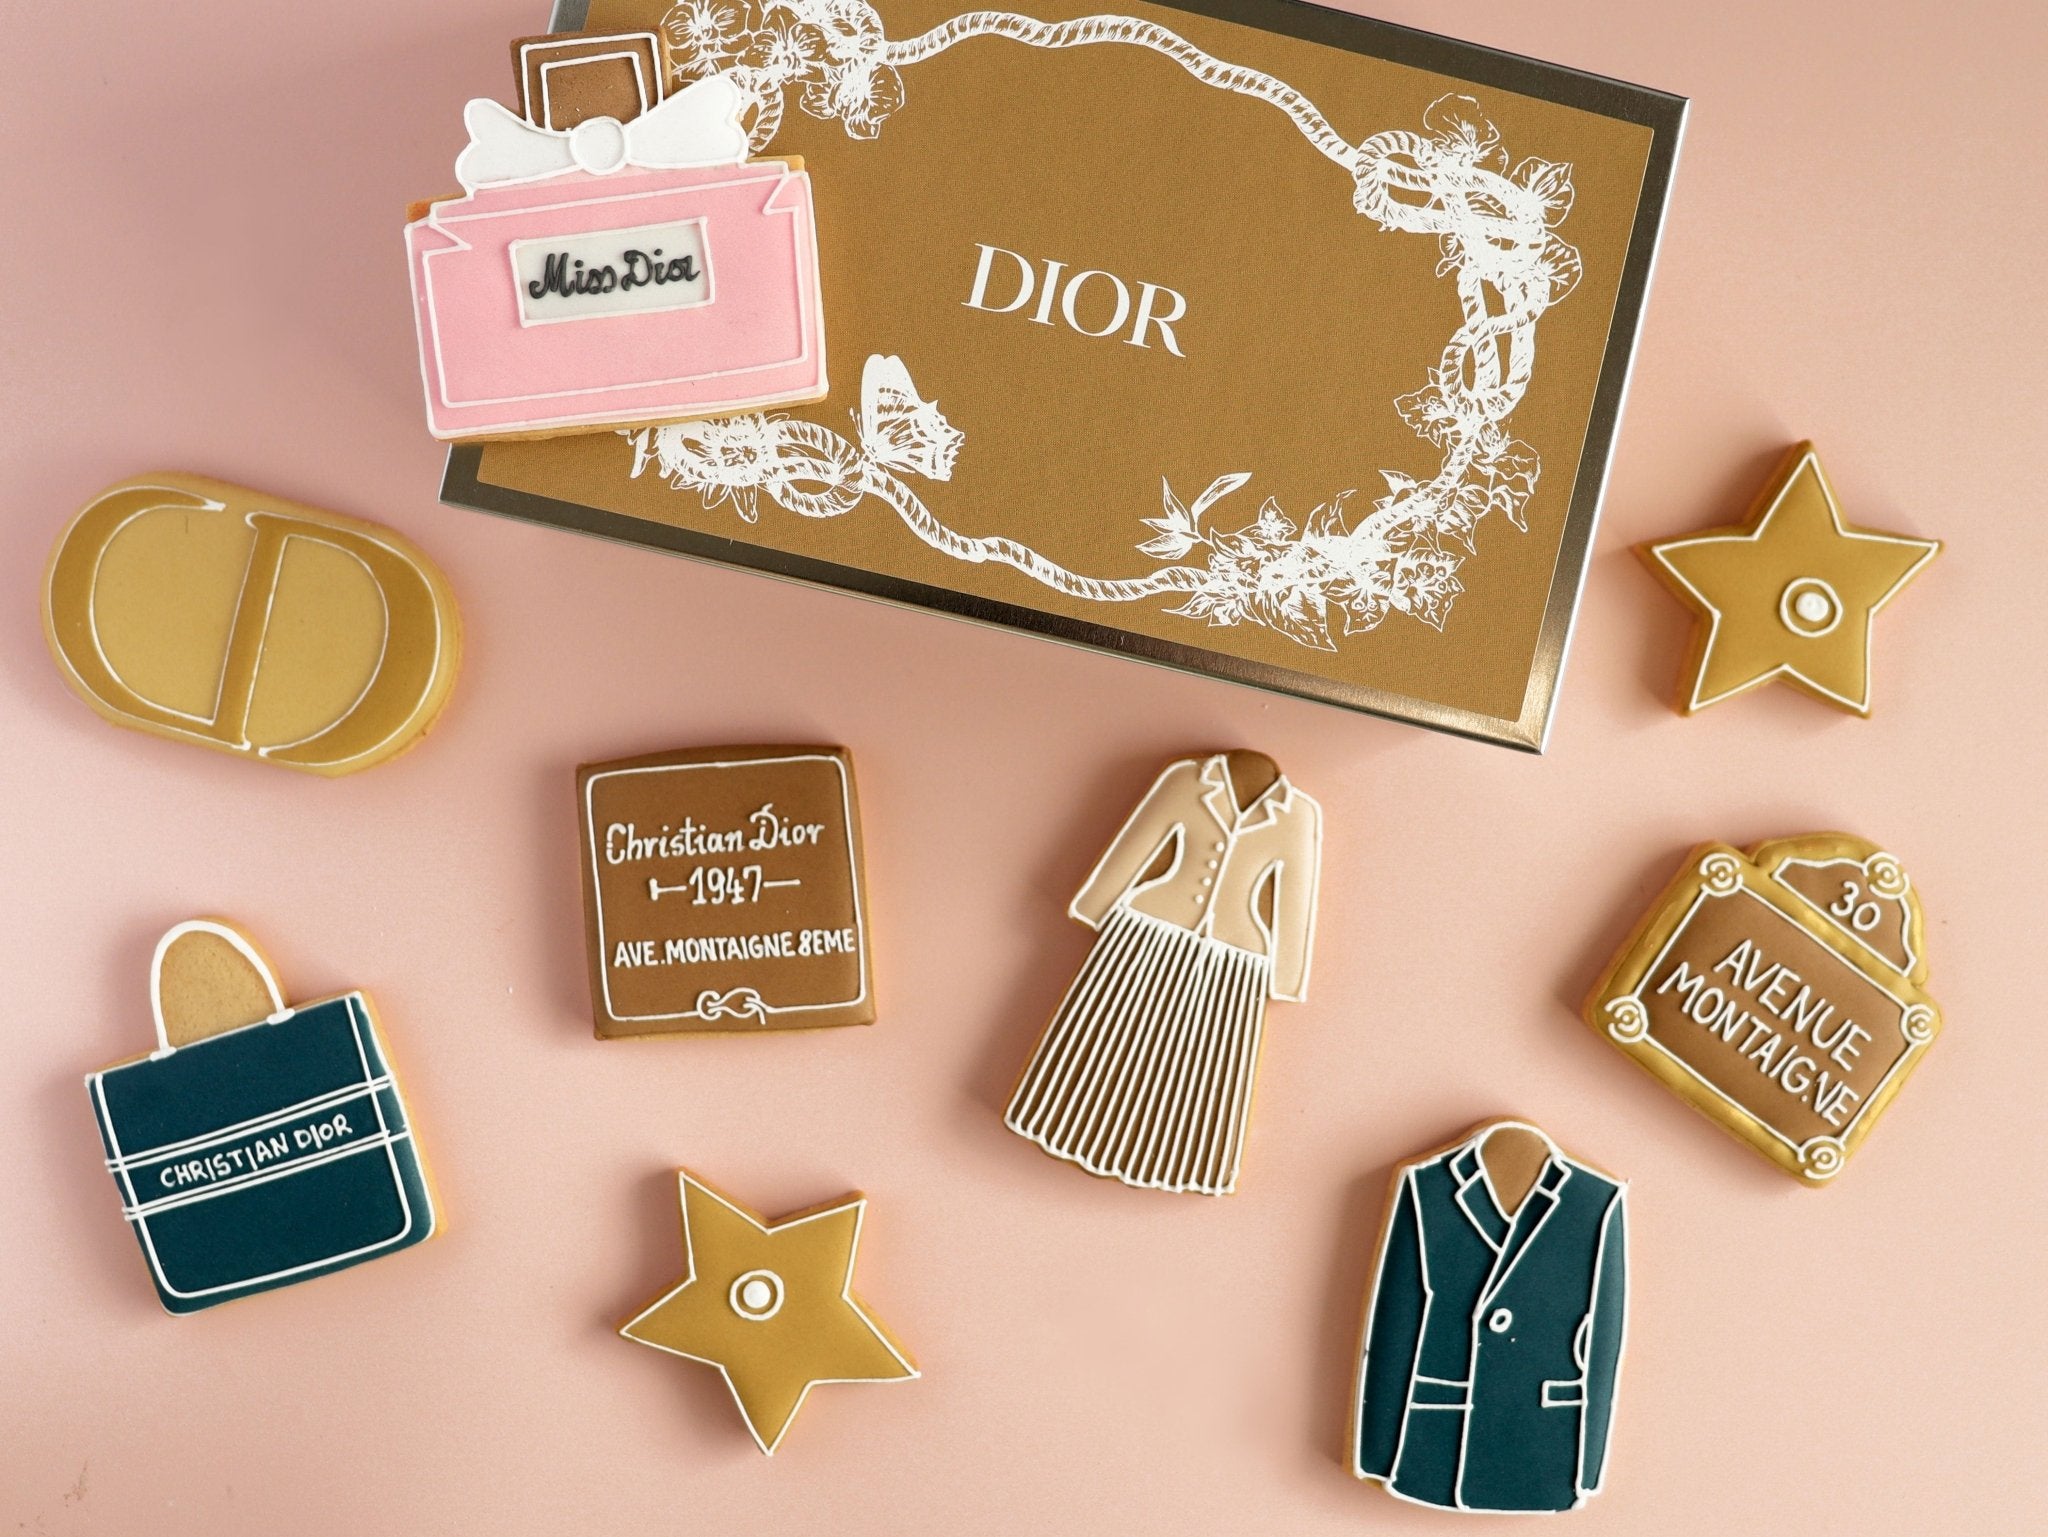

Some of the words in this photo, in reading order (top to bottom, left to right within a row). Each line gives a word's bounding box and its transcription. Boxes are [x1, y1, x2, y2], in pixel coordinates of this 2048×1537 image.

[529, 252, 617, 299] Miss
[620, 249, 700, 291] Dior
[961, 243, 1187, 358] DIOR
[606, 817, 744, 864] Christian
[749, 803, 825, 850] Dior
[1830, 881, 1881, 932] 30
[1714, 939, 1872, 1072] AVENUE
[160, 1132, 289, 1188] CHRISTIAN
[293, 1113, 353, 1149] DIOR
